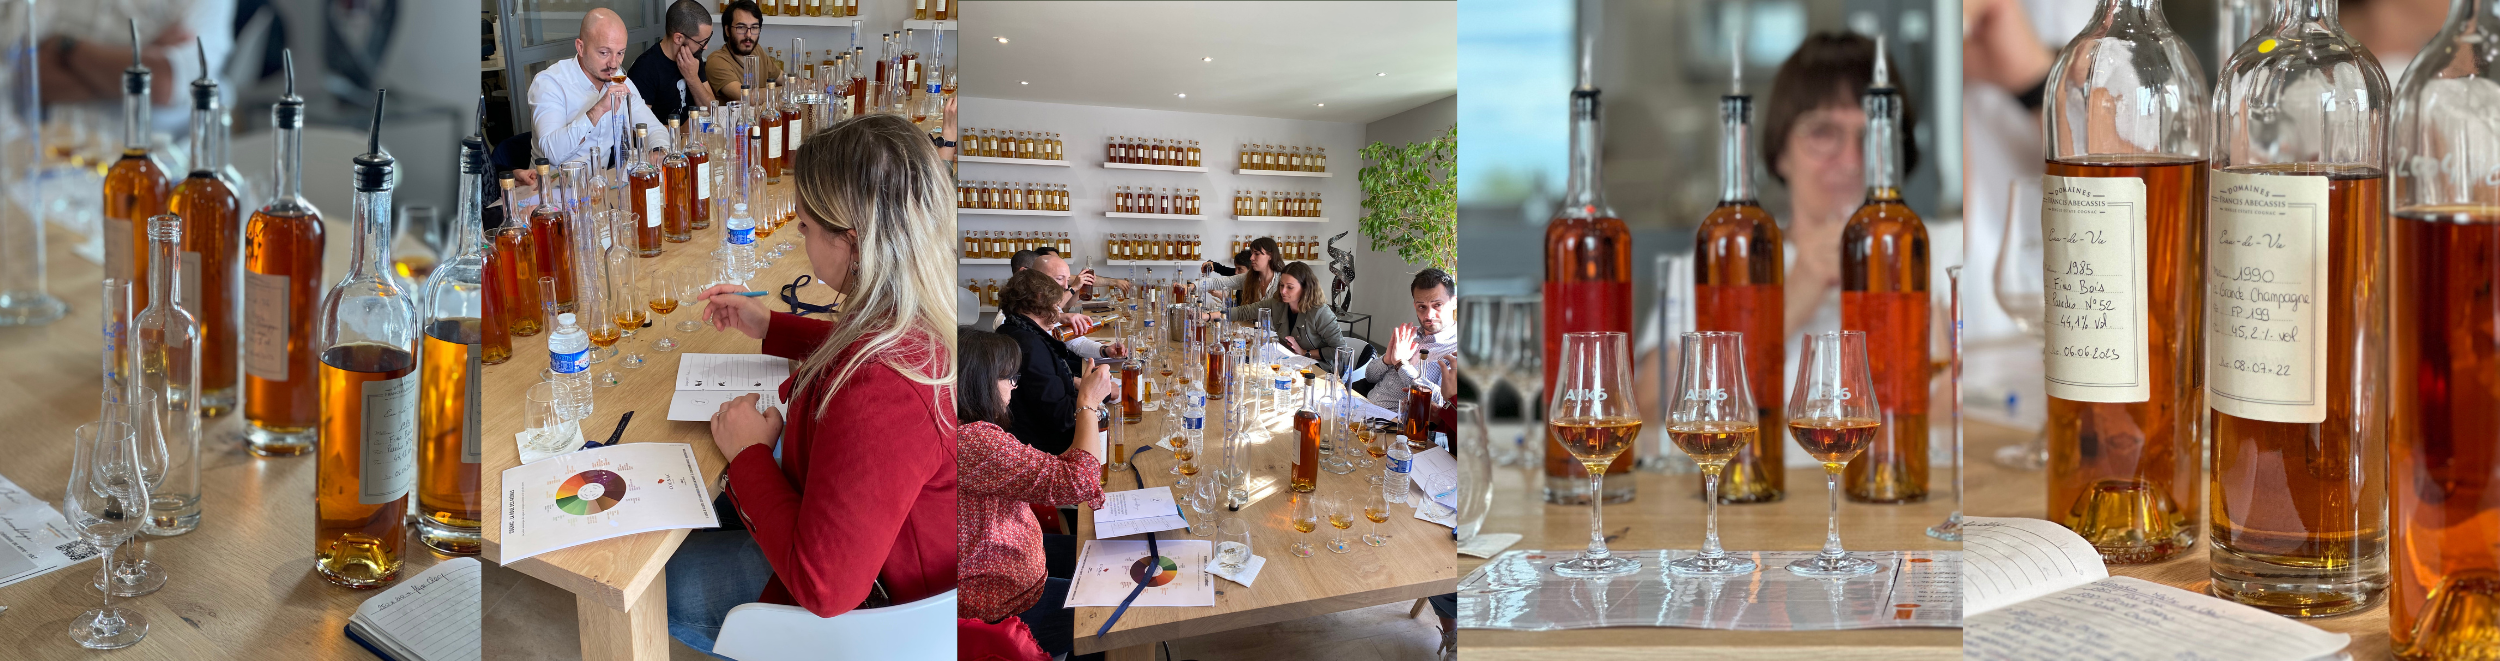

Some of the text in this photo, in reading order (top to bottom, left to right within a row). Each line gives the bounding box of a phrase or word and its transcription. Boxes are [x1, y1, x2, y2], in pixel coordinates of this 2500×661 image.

[2055, 186, 2091, 198] DOMAINES
[2228, 185, 2270, 197] DOMAINES
[2220, 196, 2286, 208] FRANCIS ABECASSIS
[2066, 260, 2094, 276] 1985
[2232, 266, 2275, 283] 1990
[2080, 279, 2105, 294] Bois
[2220, 282, 2245, 301] Grande
[2250, 287, 2311, 312] Champagne
[1683, 387, 1728, 401] ABK6
